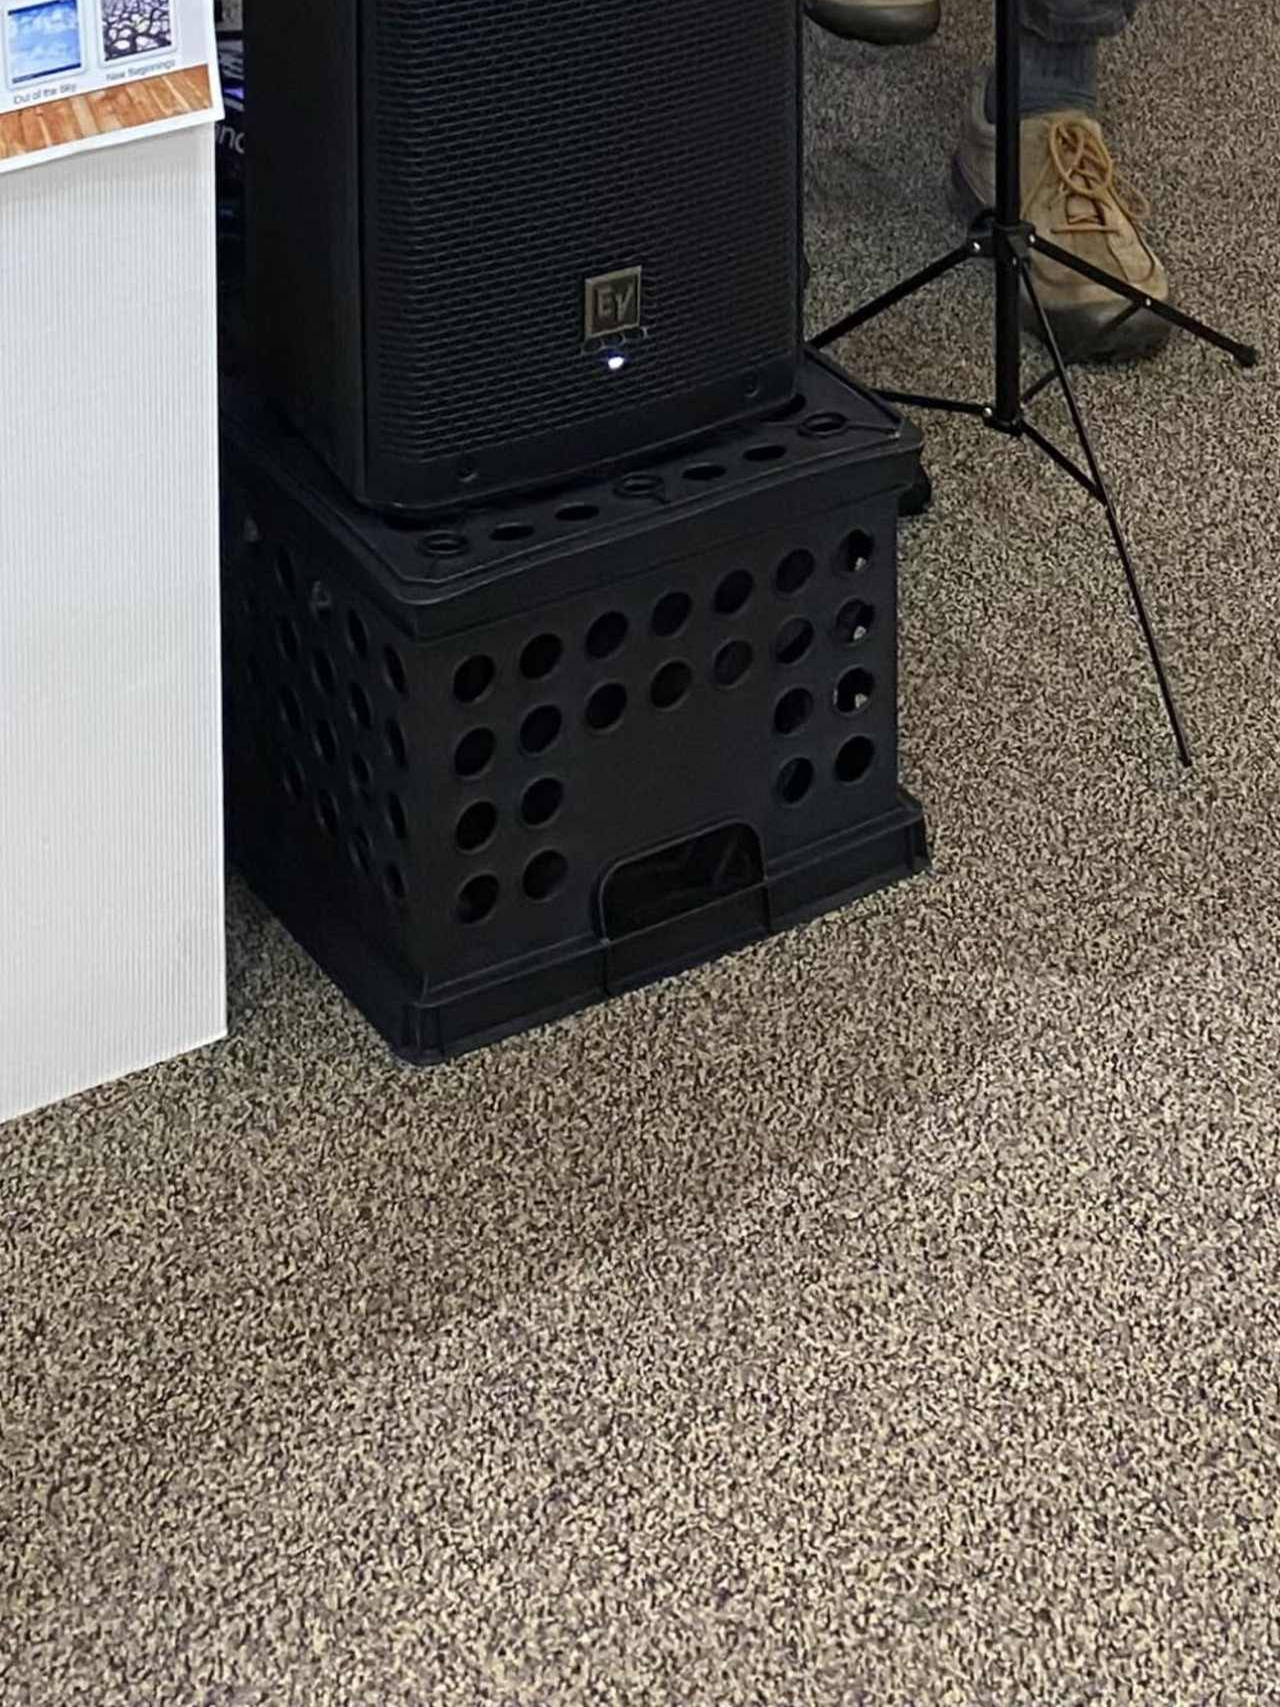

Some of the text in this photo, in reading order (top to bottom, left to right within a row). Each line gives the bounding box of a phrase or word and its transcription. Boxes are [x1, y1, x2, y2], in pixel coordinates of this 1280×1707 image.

[13, 92, 31, 105] Out
[43, 86, 58, 98] the
[596, 282, 633, 323] EV
